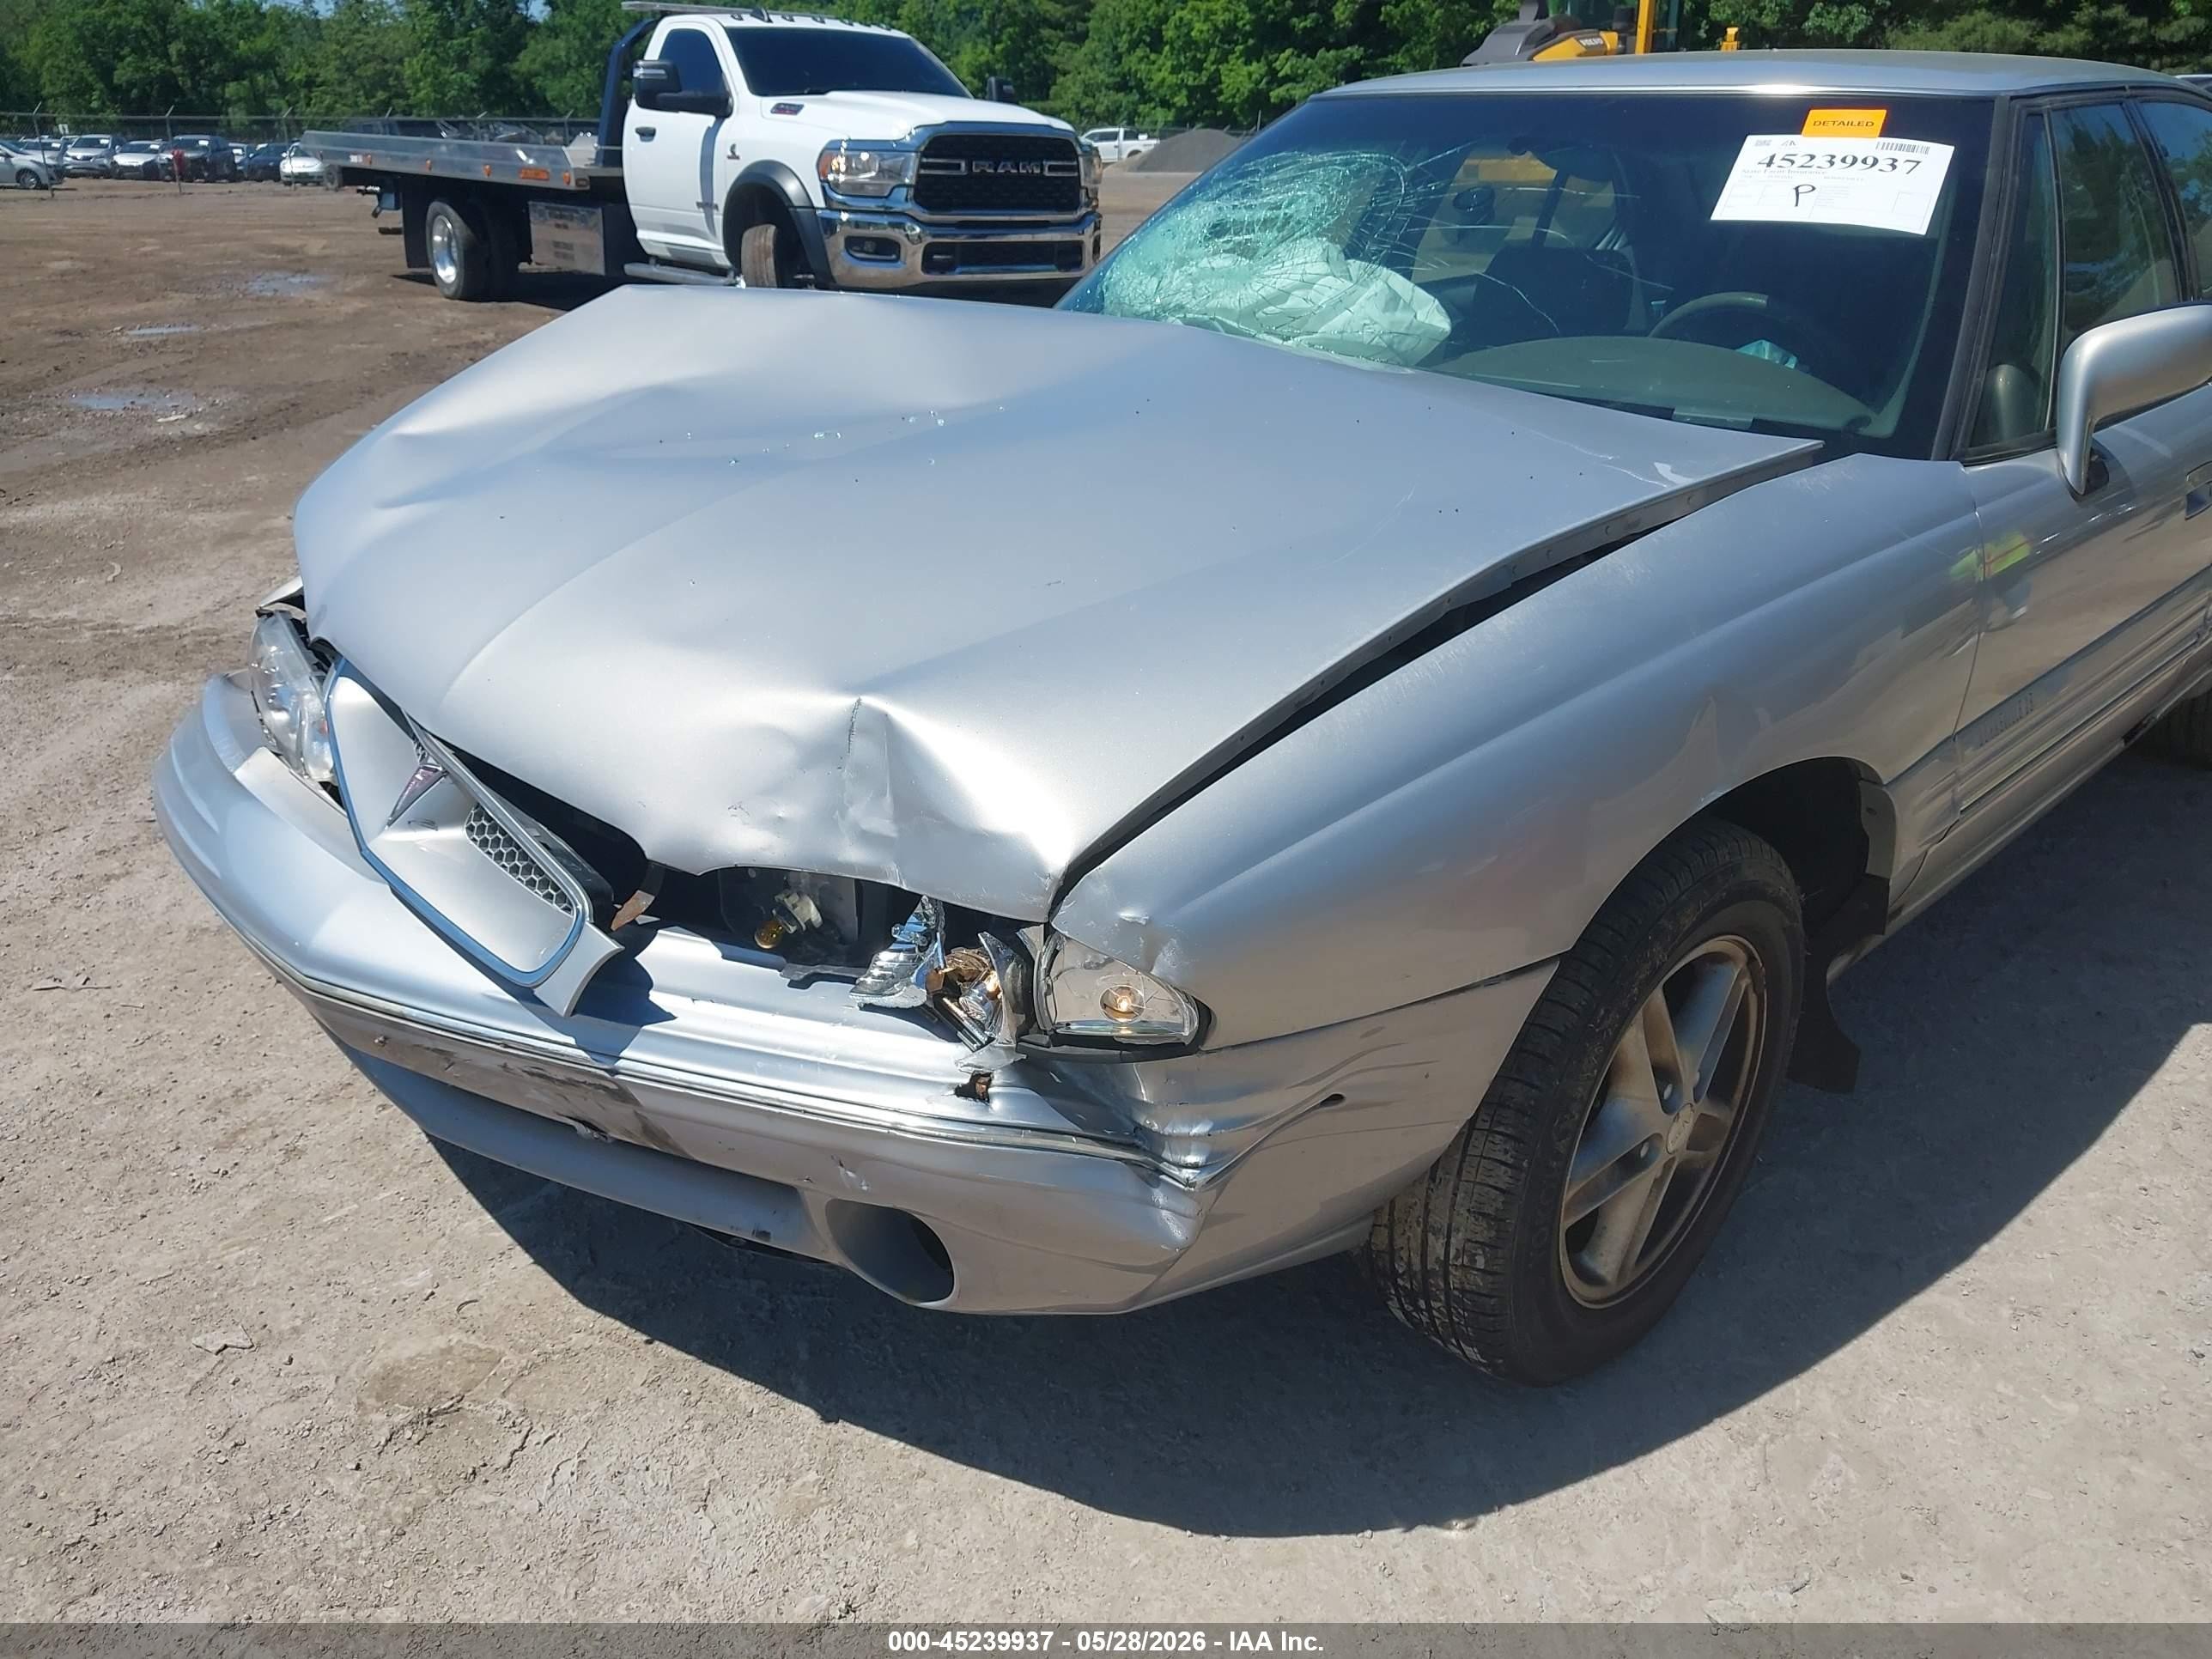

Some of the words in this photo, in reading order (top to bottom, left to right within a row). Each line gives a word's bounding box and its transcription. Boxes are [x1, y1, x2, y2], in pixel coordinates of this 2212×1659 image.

[972, 161, 1041, 173] RAM
[1757, 153, 1921, 174] 45239937
[1793, 184, 1816, 207] P
